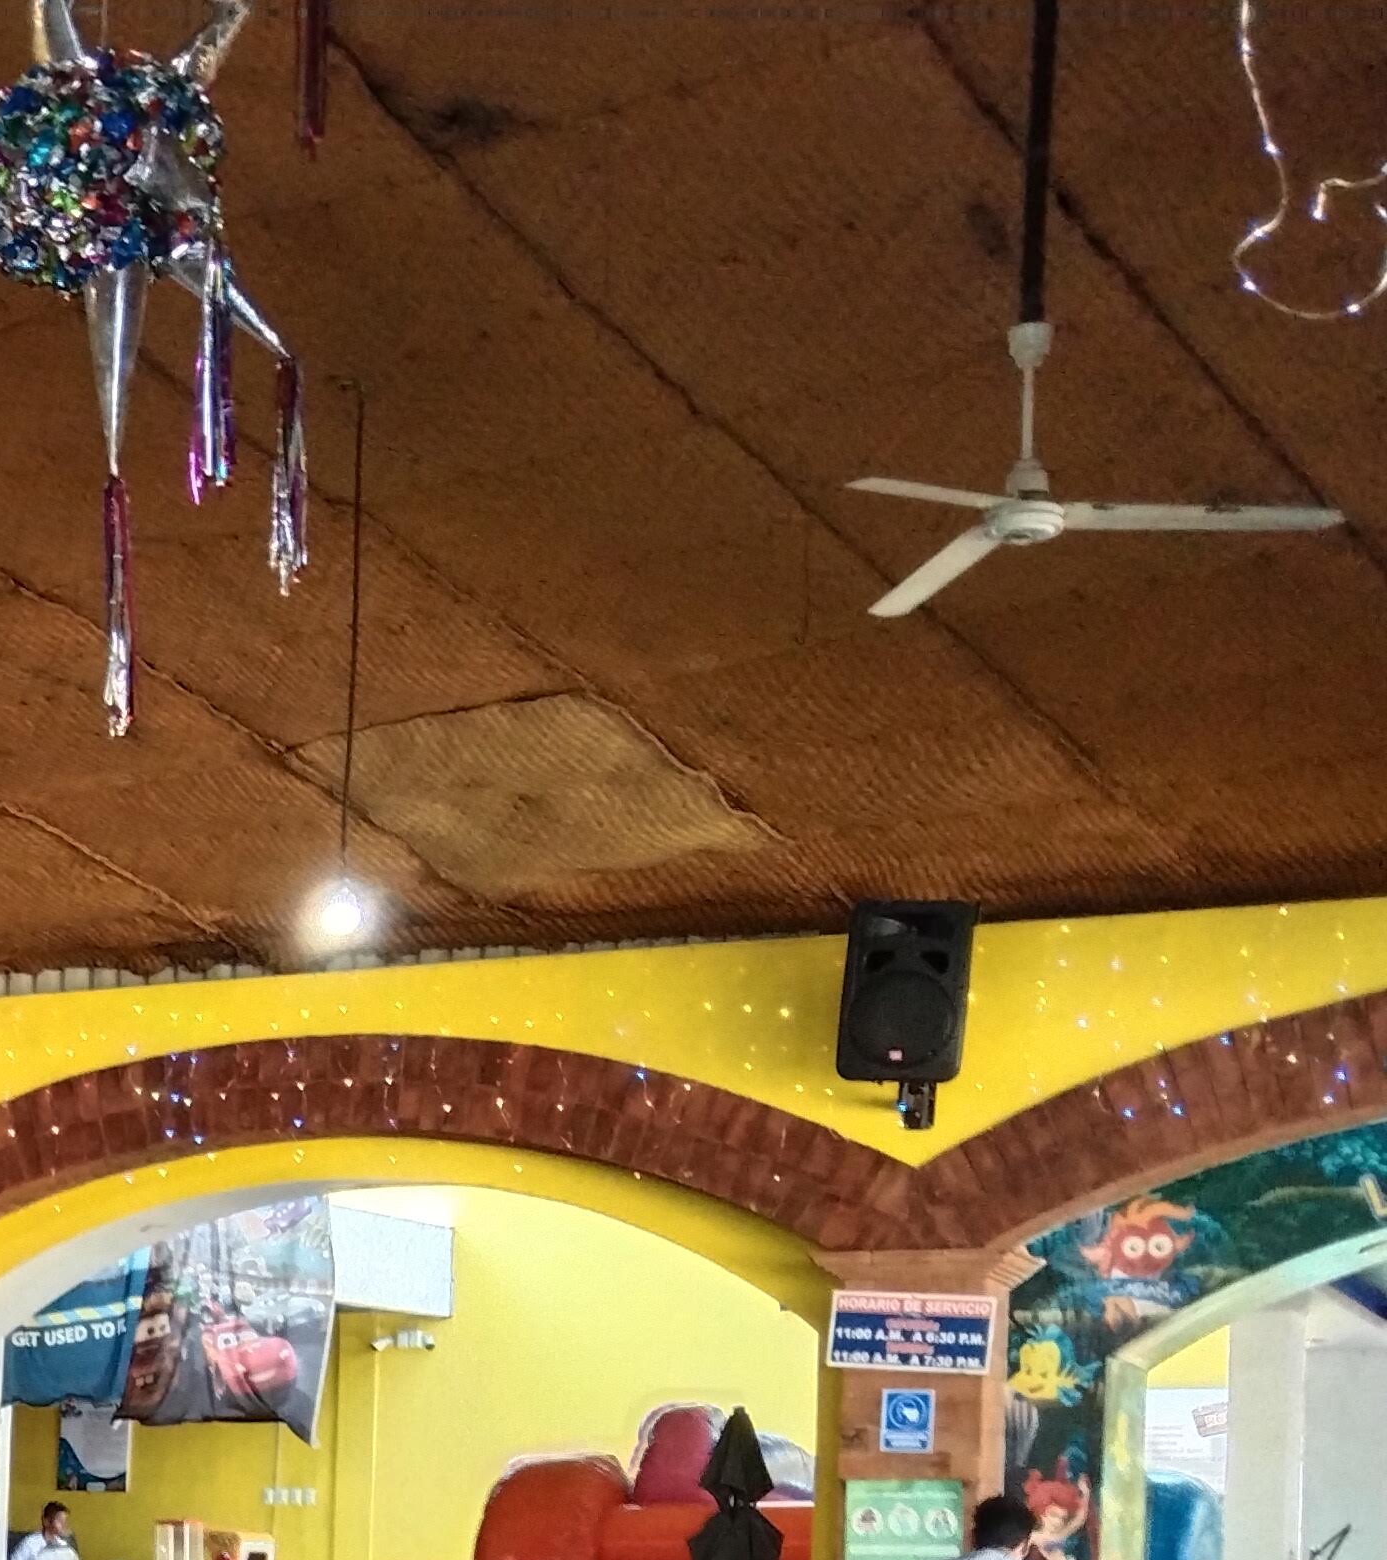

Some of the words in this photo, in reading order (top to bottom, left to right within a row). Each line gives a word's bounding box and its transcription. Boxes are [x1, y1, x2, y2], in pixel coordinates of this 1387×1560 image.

[838, 1298, 901, 1312] HORARIO
[903, 1300, 922, 1313] DE
[924, 1302, 990, 1316] SERVICIO
[44, 1325, 88, 1347] USED
[90, 1321, 115, 1340] TO
[836, 1327, 873, 1340] 11:00
[875, 1330, 905, 1342] A.M.
[912, 1331, 923, 1343] A
[958, 1333, 986, 1346] P.M.
